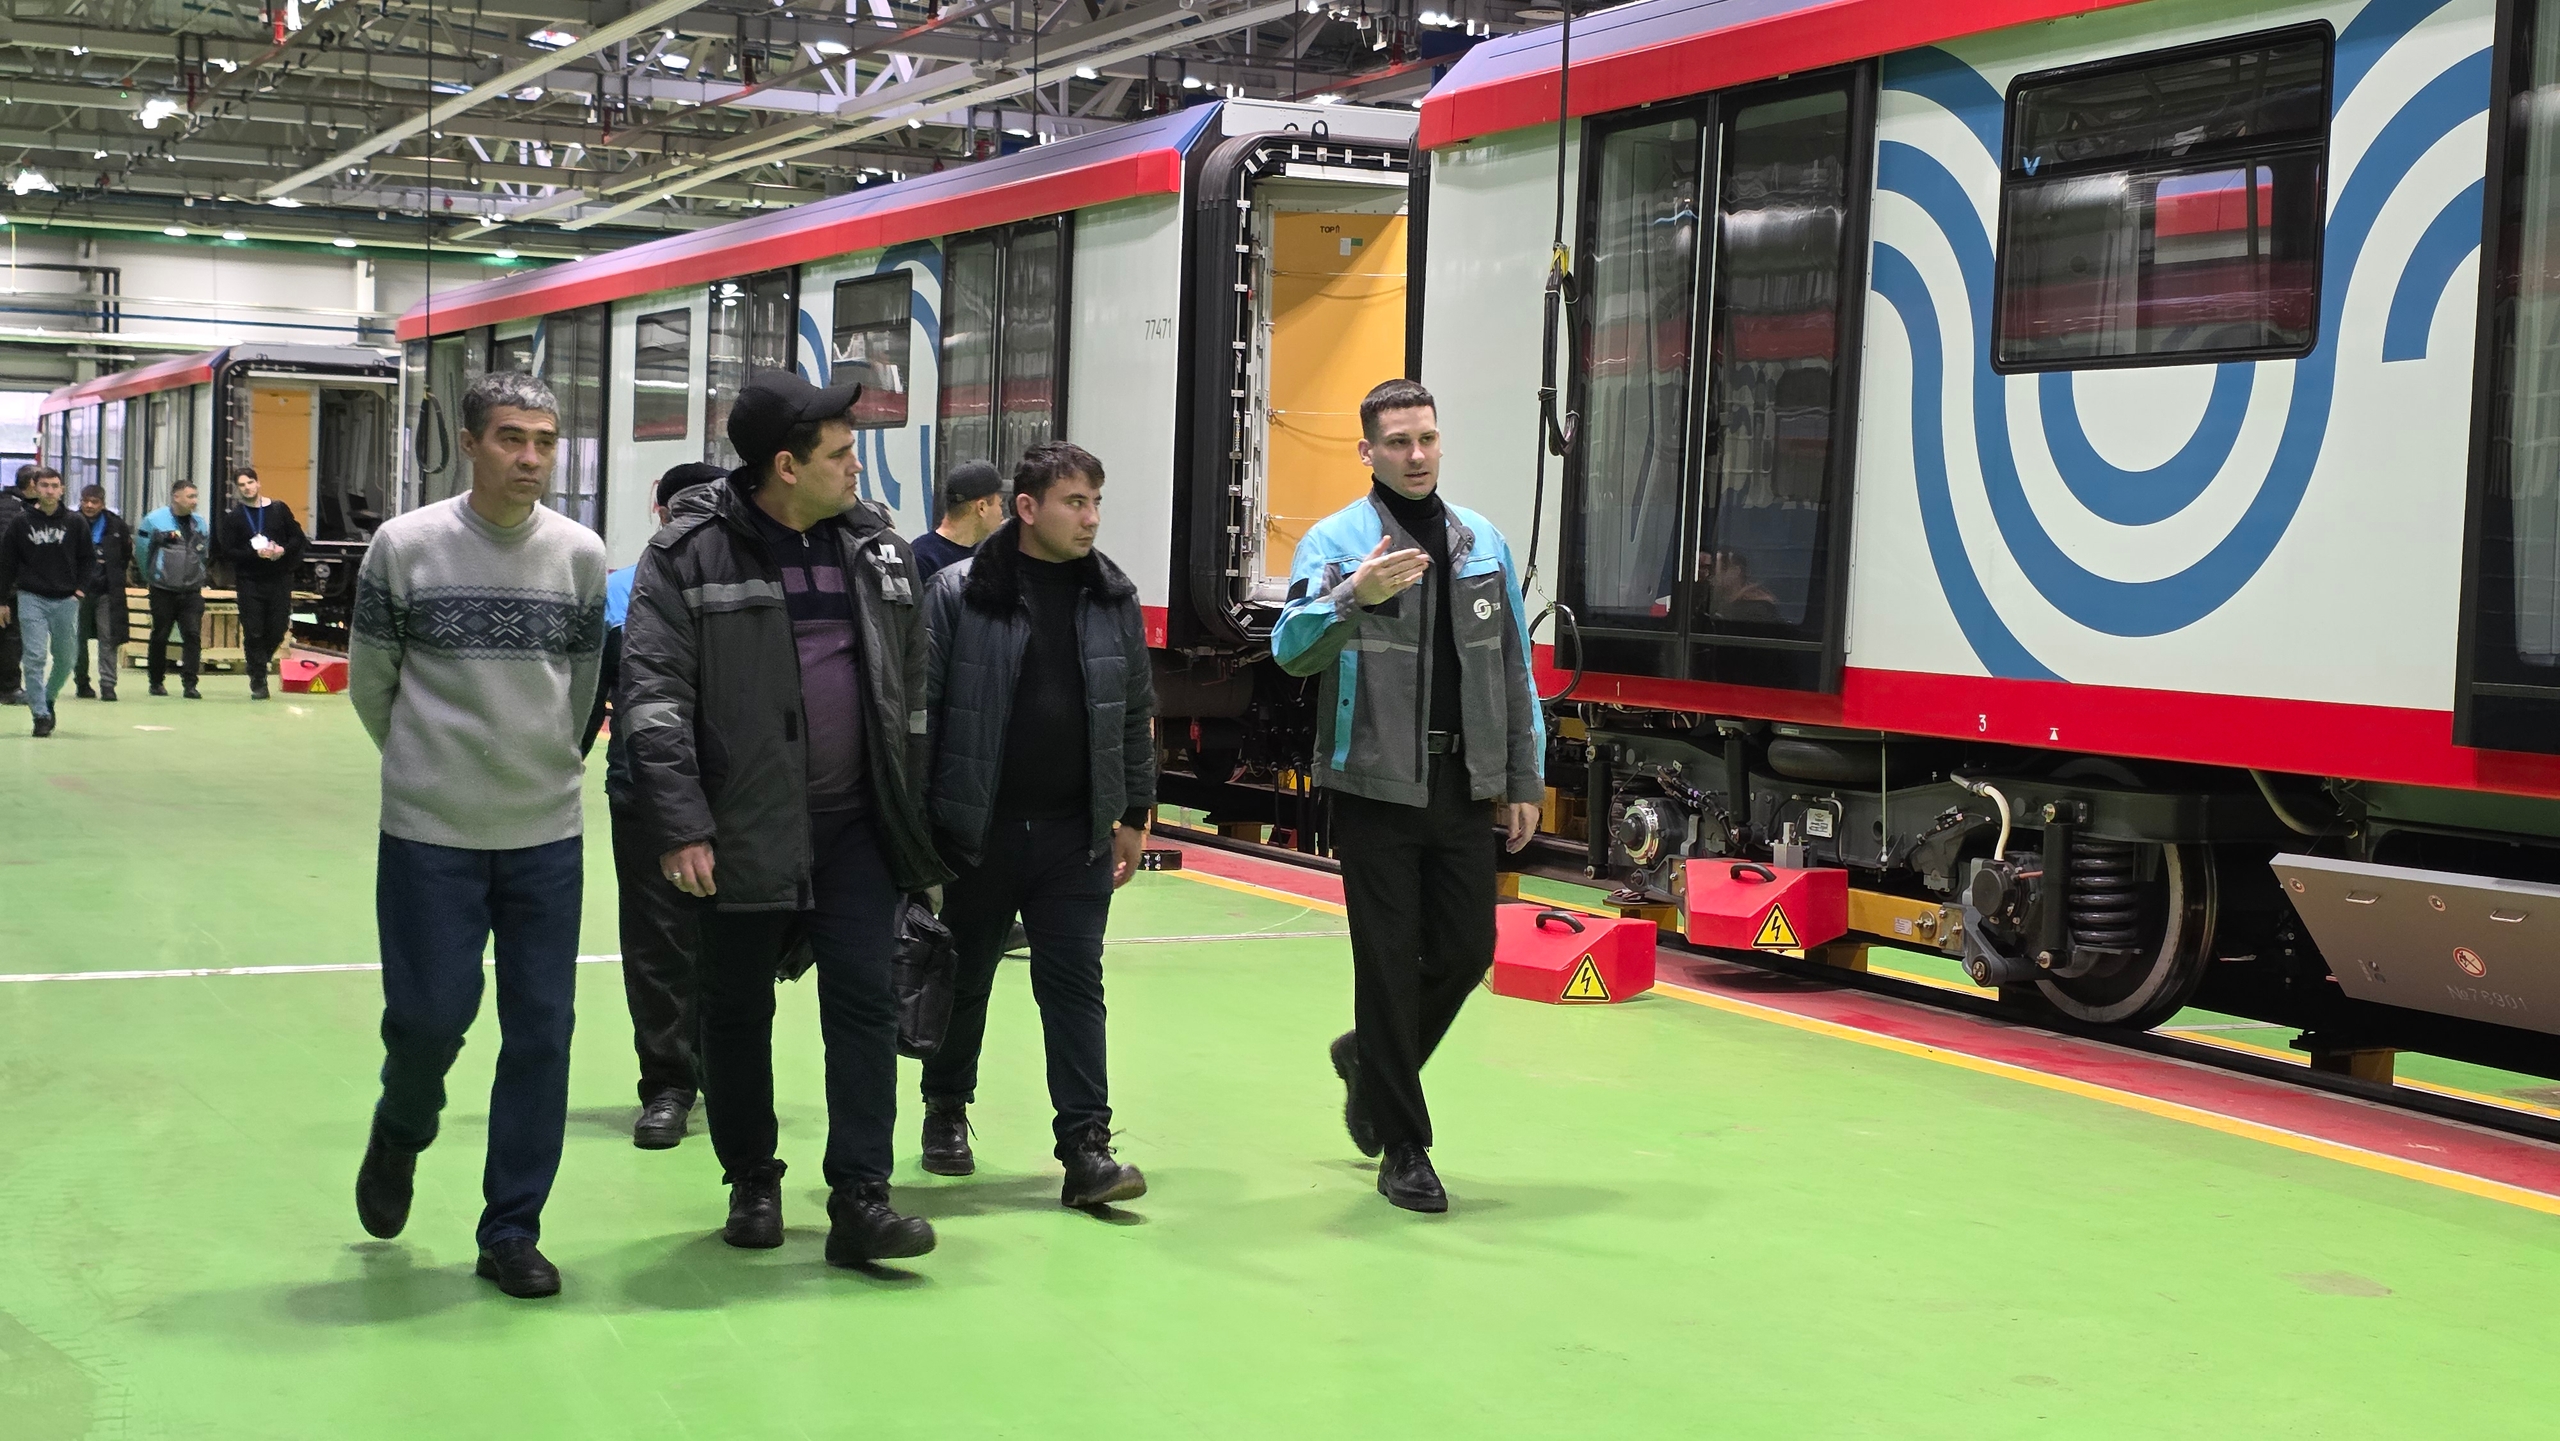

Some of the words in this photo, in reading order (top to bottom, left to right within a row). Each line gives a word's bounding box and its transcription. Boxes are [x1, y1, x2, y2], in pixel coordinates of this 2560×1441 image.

[1320, 225, 1335, 234] TOP
[1145, 317, 1172, 340] 77471
[1616, 681, 1620, 697] 1
[1978, 714, 1987, 732] 3
